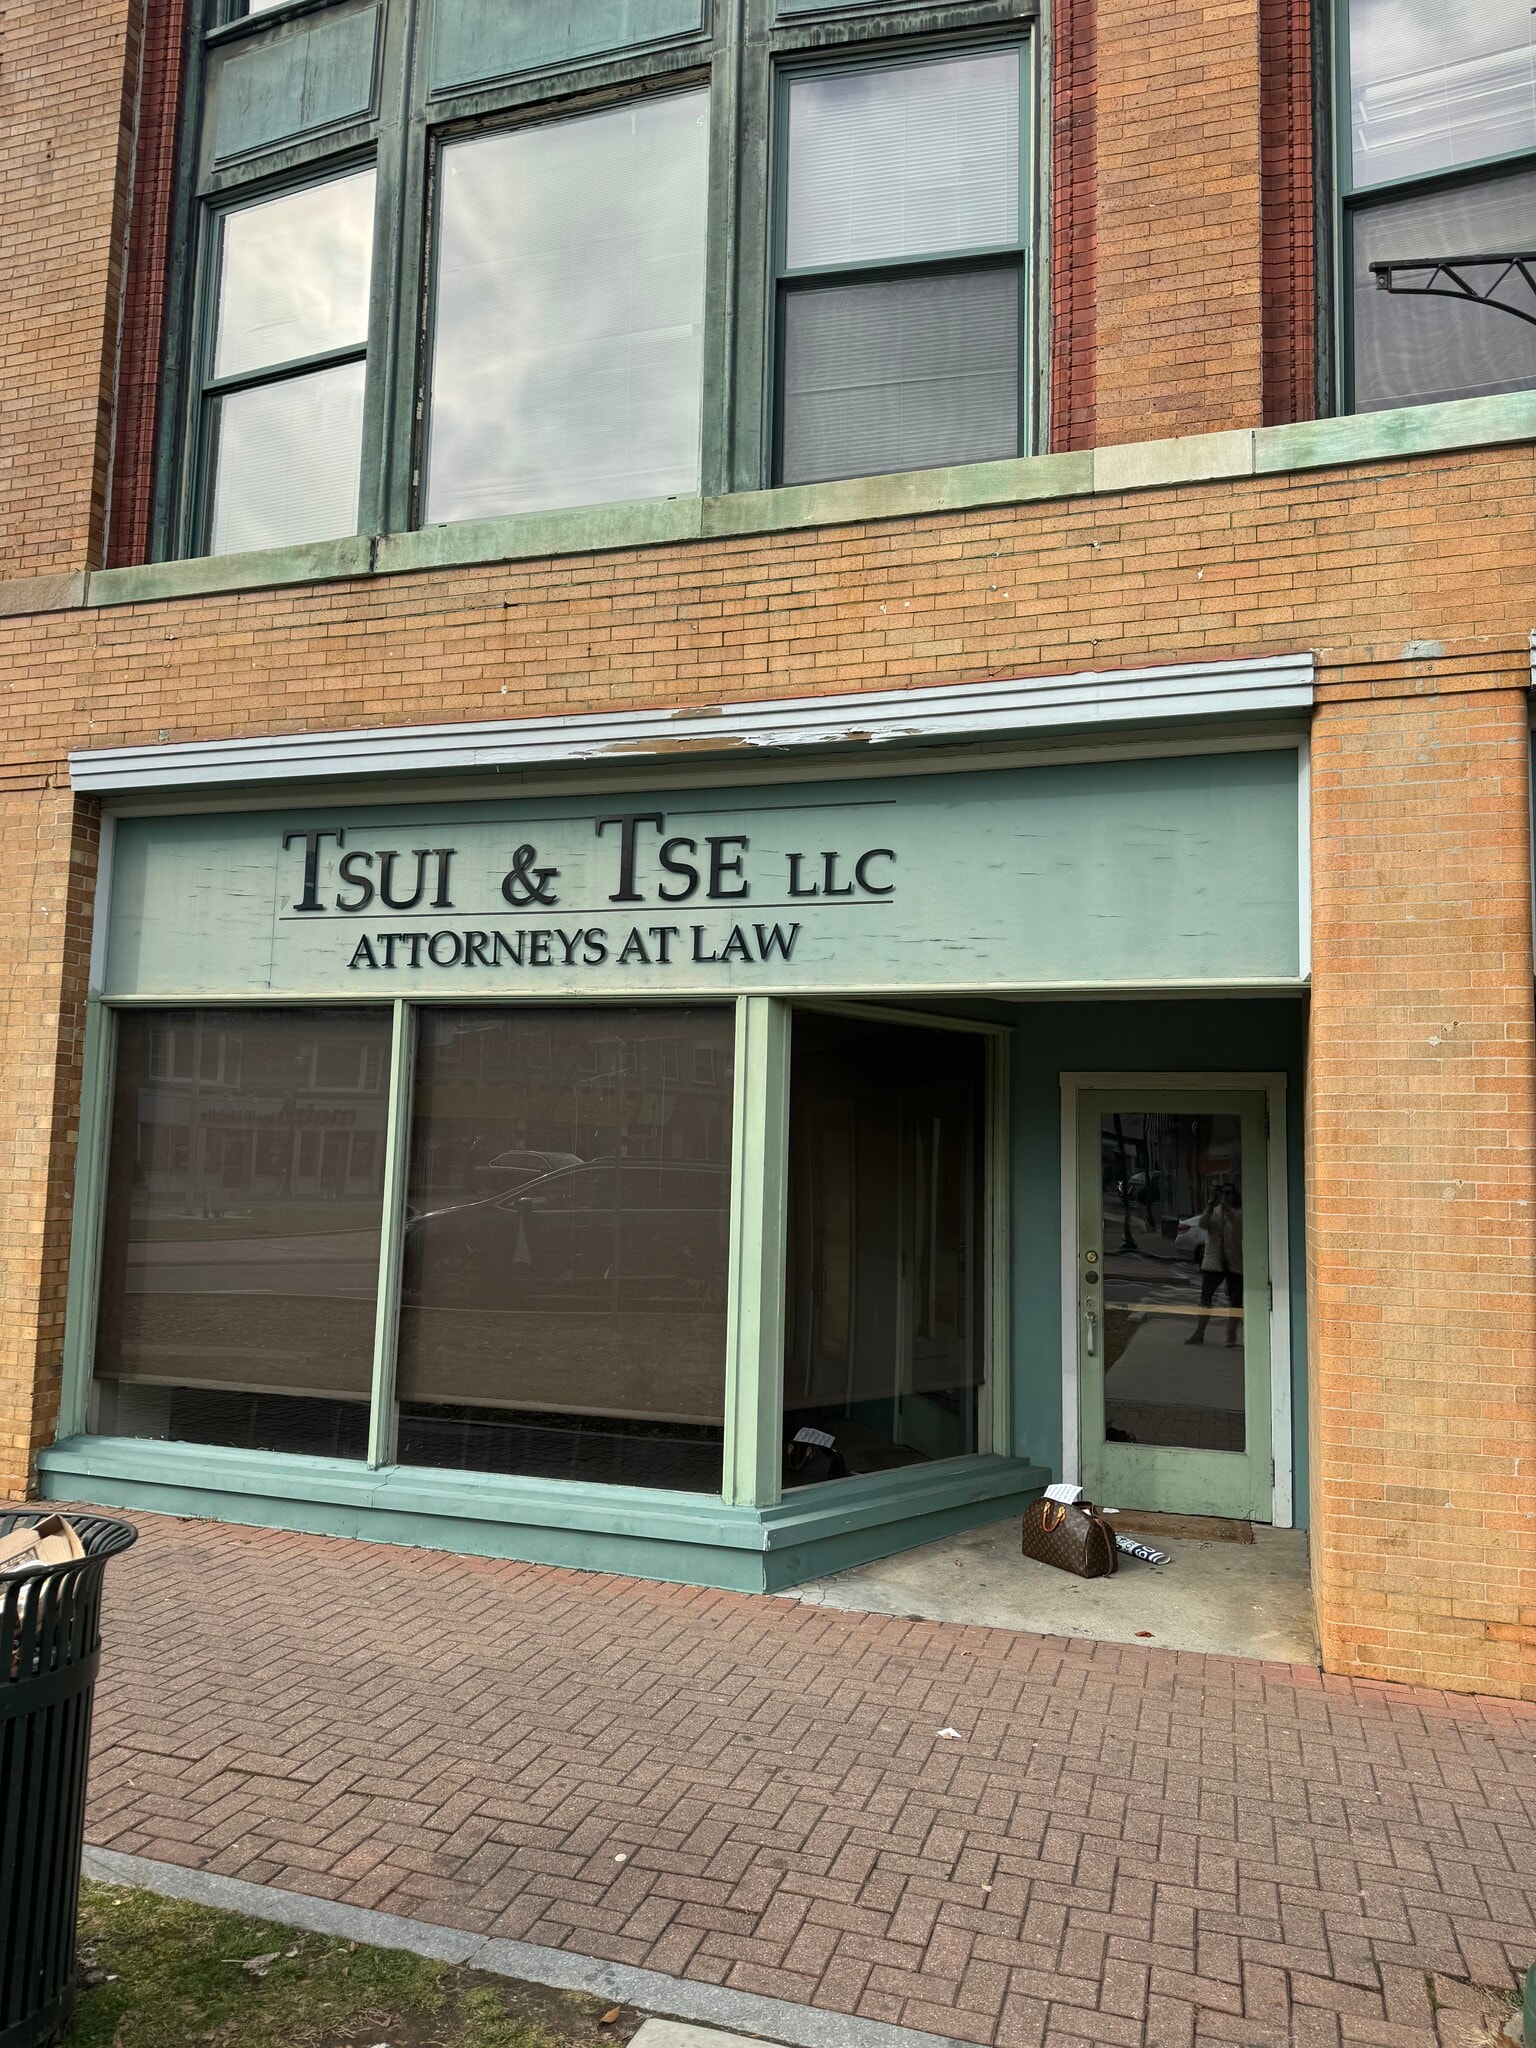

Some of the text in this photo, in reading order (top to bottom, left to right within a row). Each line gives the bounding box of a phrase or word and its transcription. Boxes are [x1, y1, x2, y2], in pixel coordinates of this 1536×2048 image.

[282, 812, 894, 911] TSUI & TSE LLC
[347, 923, 800, 968] ATTORNEYS AT LAW
